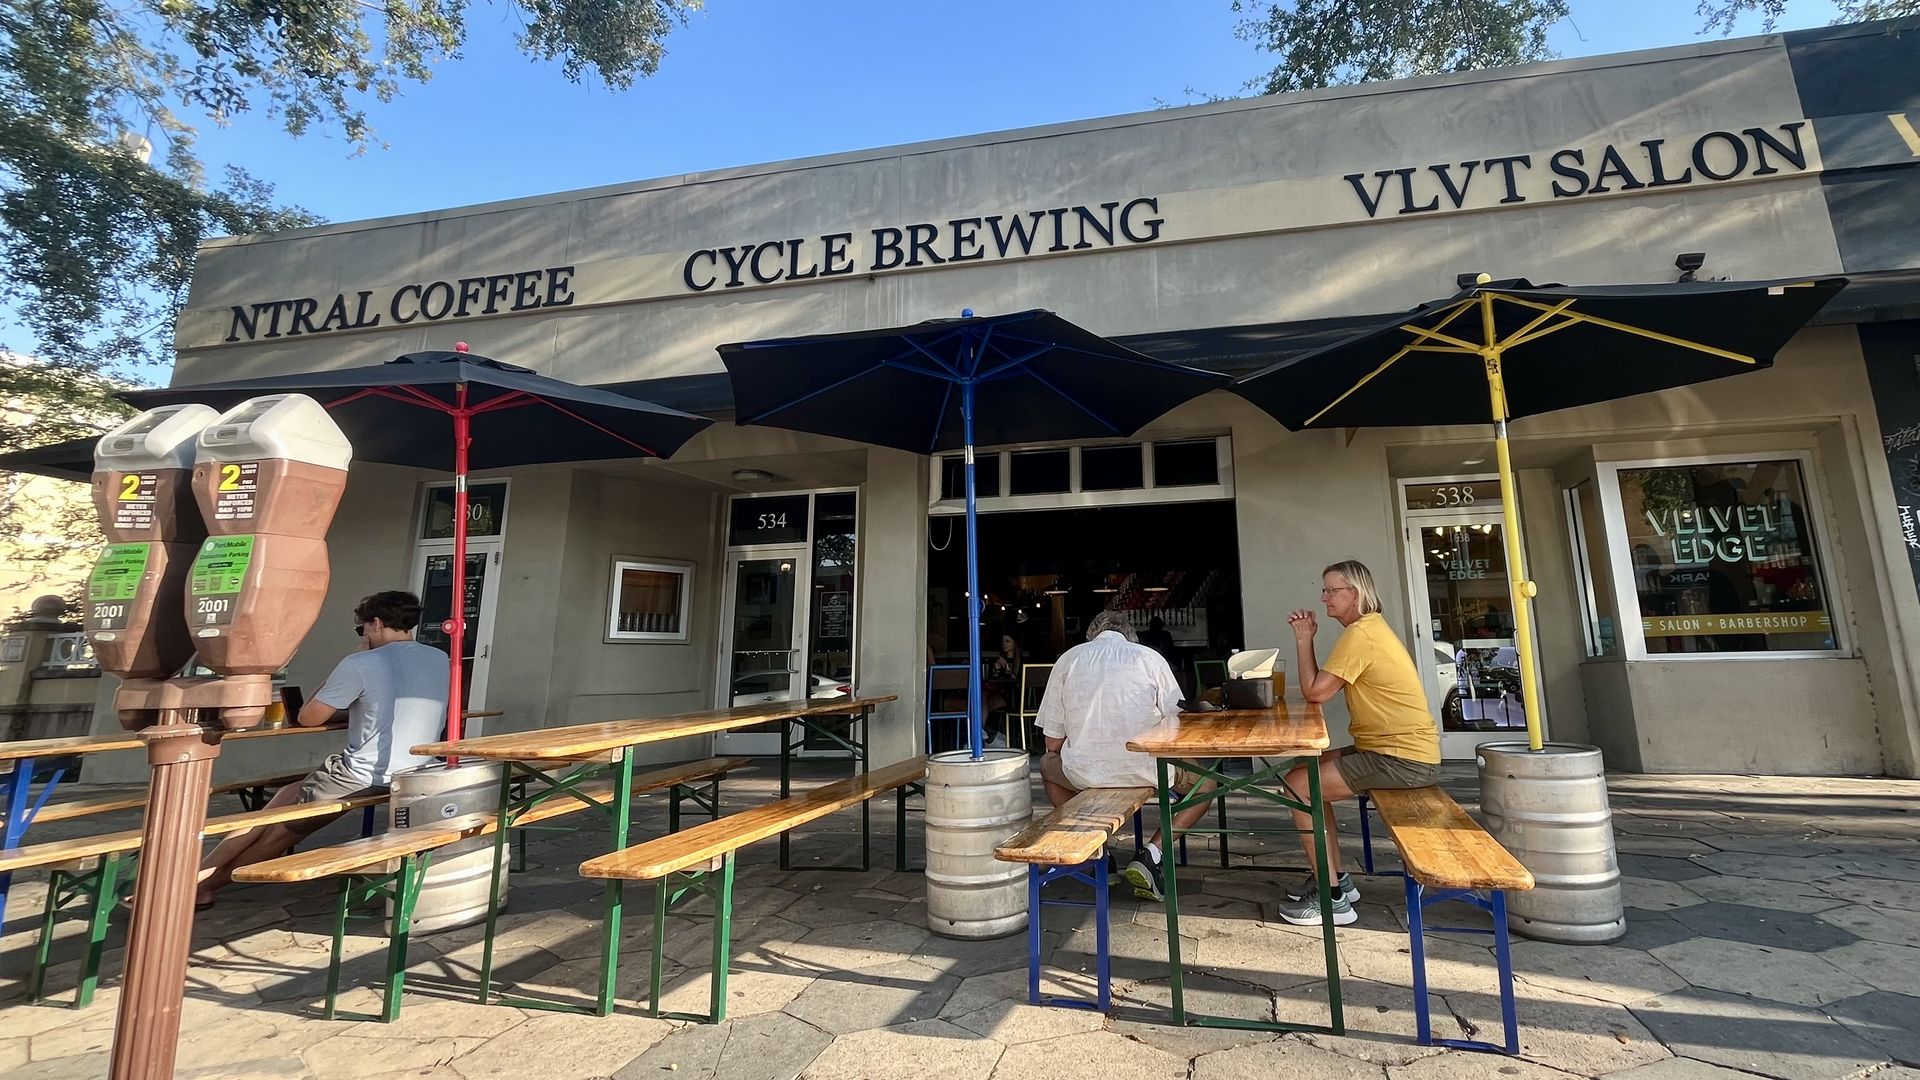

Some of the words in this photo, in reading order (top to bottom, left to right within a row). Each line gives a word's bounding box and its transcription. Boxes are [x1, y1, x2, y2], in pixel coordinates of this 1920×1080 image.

[1344, 155, 1532, 218] VLVT
[1550, 121, 1806, 198] SALON
[683, 232, 854, 292] CYCLE
[870, 197, 1165, 271] BREWING
[225, 291, 381, 342] NTRAL
[390, 266, 575, 323] COFFEE
[119, 474, 140, 500] 2
[219, 464, 240, 491] 2
[1436, 485, 1475, 506] 538
[757, 512, 787, 530] 534
[1645, 504, 1777, 537] VELVET
[1671, 534, 1769, 564] EDGE
[1440, 559, 1491, 571] VELVET
[1449, 569, 1486, 581] EDGE
[93, 605, 124, 618] 2001
[197, 599, 229, 613] 2001
[1659, 619, 1700, 631] SALON
[1719, 616, 1808, 630] BARBERSHOP
